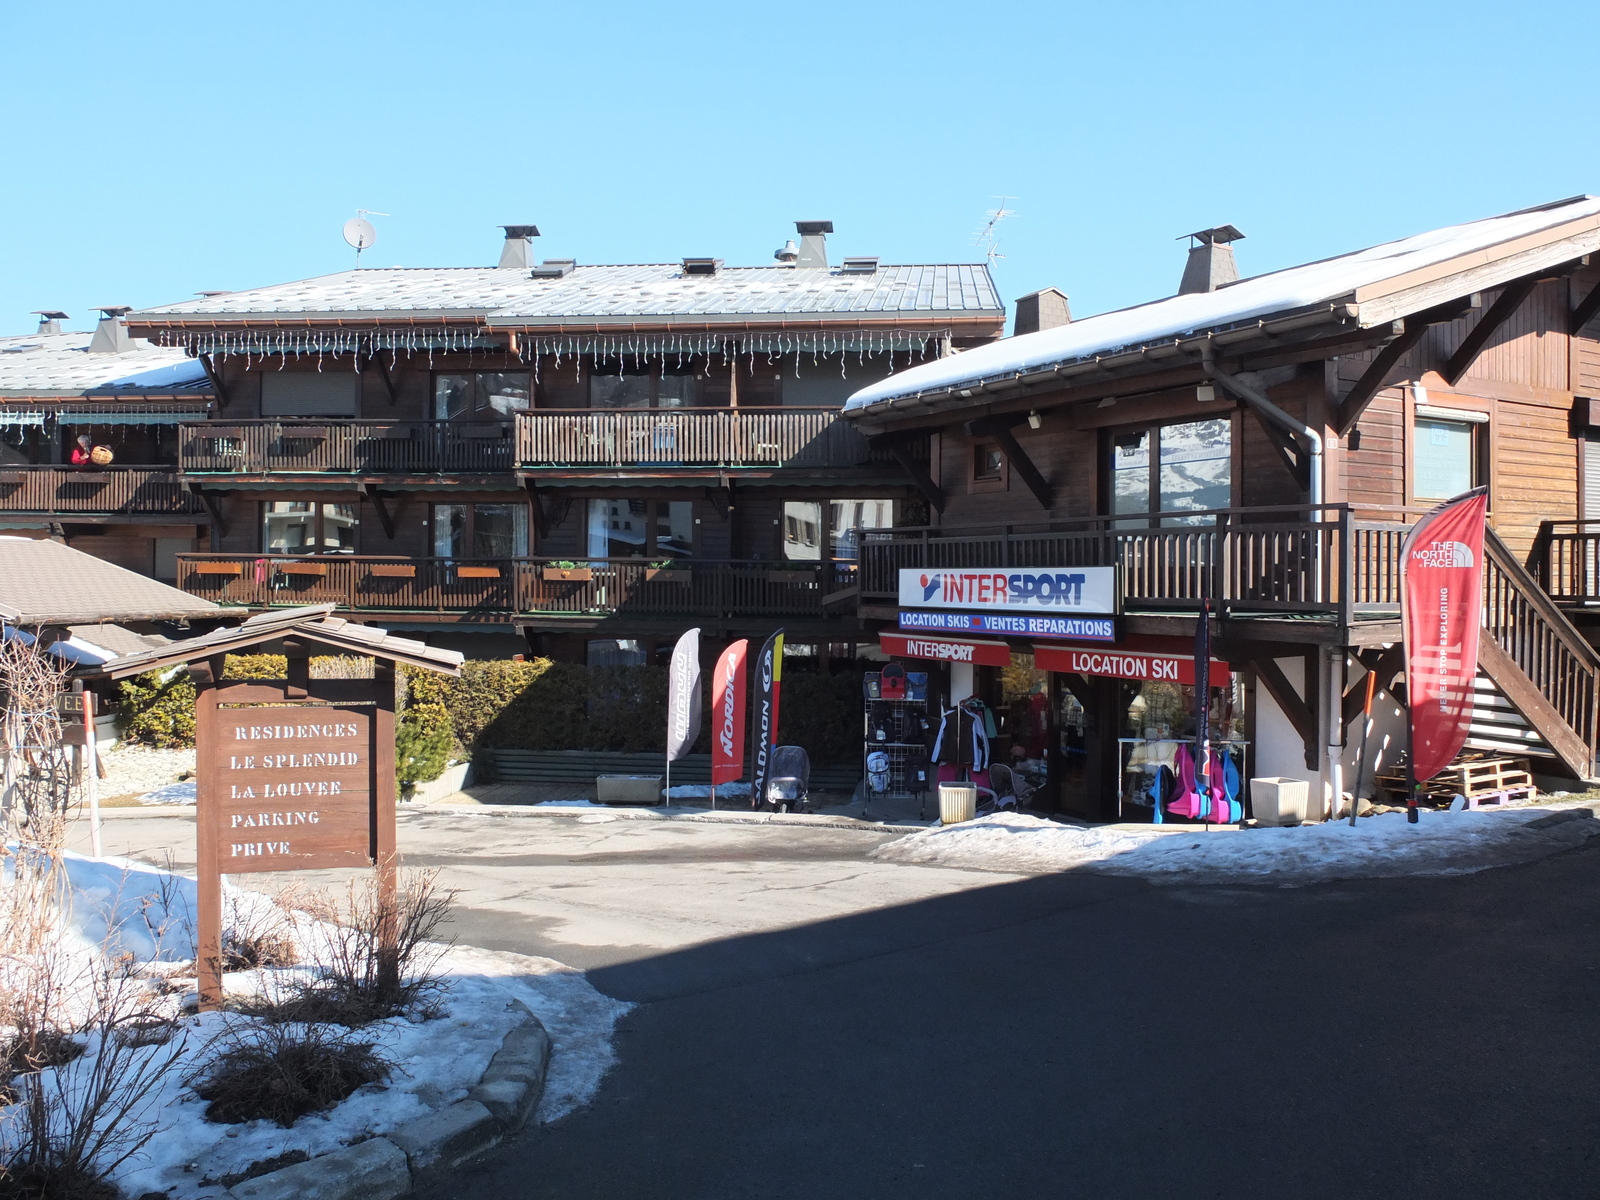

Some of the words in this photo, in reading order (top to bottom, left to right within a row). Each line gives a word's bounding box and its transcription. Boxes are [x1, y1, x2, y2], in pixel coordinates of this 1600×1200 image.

[1412, 550, 1453, 559] NORTH
[1431, 541, 1453, 550] THE
[1423, 558, 1452, 568] FACE
[943, 573, 1086, 606] INTERSPORT
[900, 613, 945, 628] LOCATION
[947, 615, 970, 629] SKIS
[984, 616, 1026, 632] VENTES
[1028, 618, 1112, 637] REPARATIONS
[1440, 587, 1449, 646] EXPLORING
[906, 639, 975, 661] INTERSPORT
[1072, 653, 1148, 679] LOCATION
[1151, 659, 1179, 680] SKI
[1439, 651, 1447, 675] STOP
[719, 652, 737, 758] NORDICA
[1439, 678, 1447, 713] NEVER
[235, 723, 358, 740] RESIDENCES
[230, 755, 256, 770] LE
[262, 752, 358, 768] SPLENDID
[755, 700, 770, 806] SALOMON
[230, 785, 256, 799] LA
[263, 780, 342, 798] LOUVEE
[230, 811, 321, 828] PARKING
[230, 841, 290, 857] PRIVE
